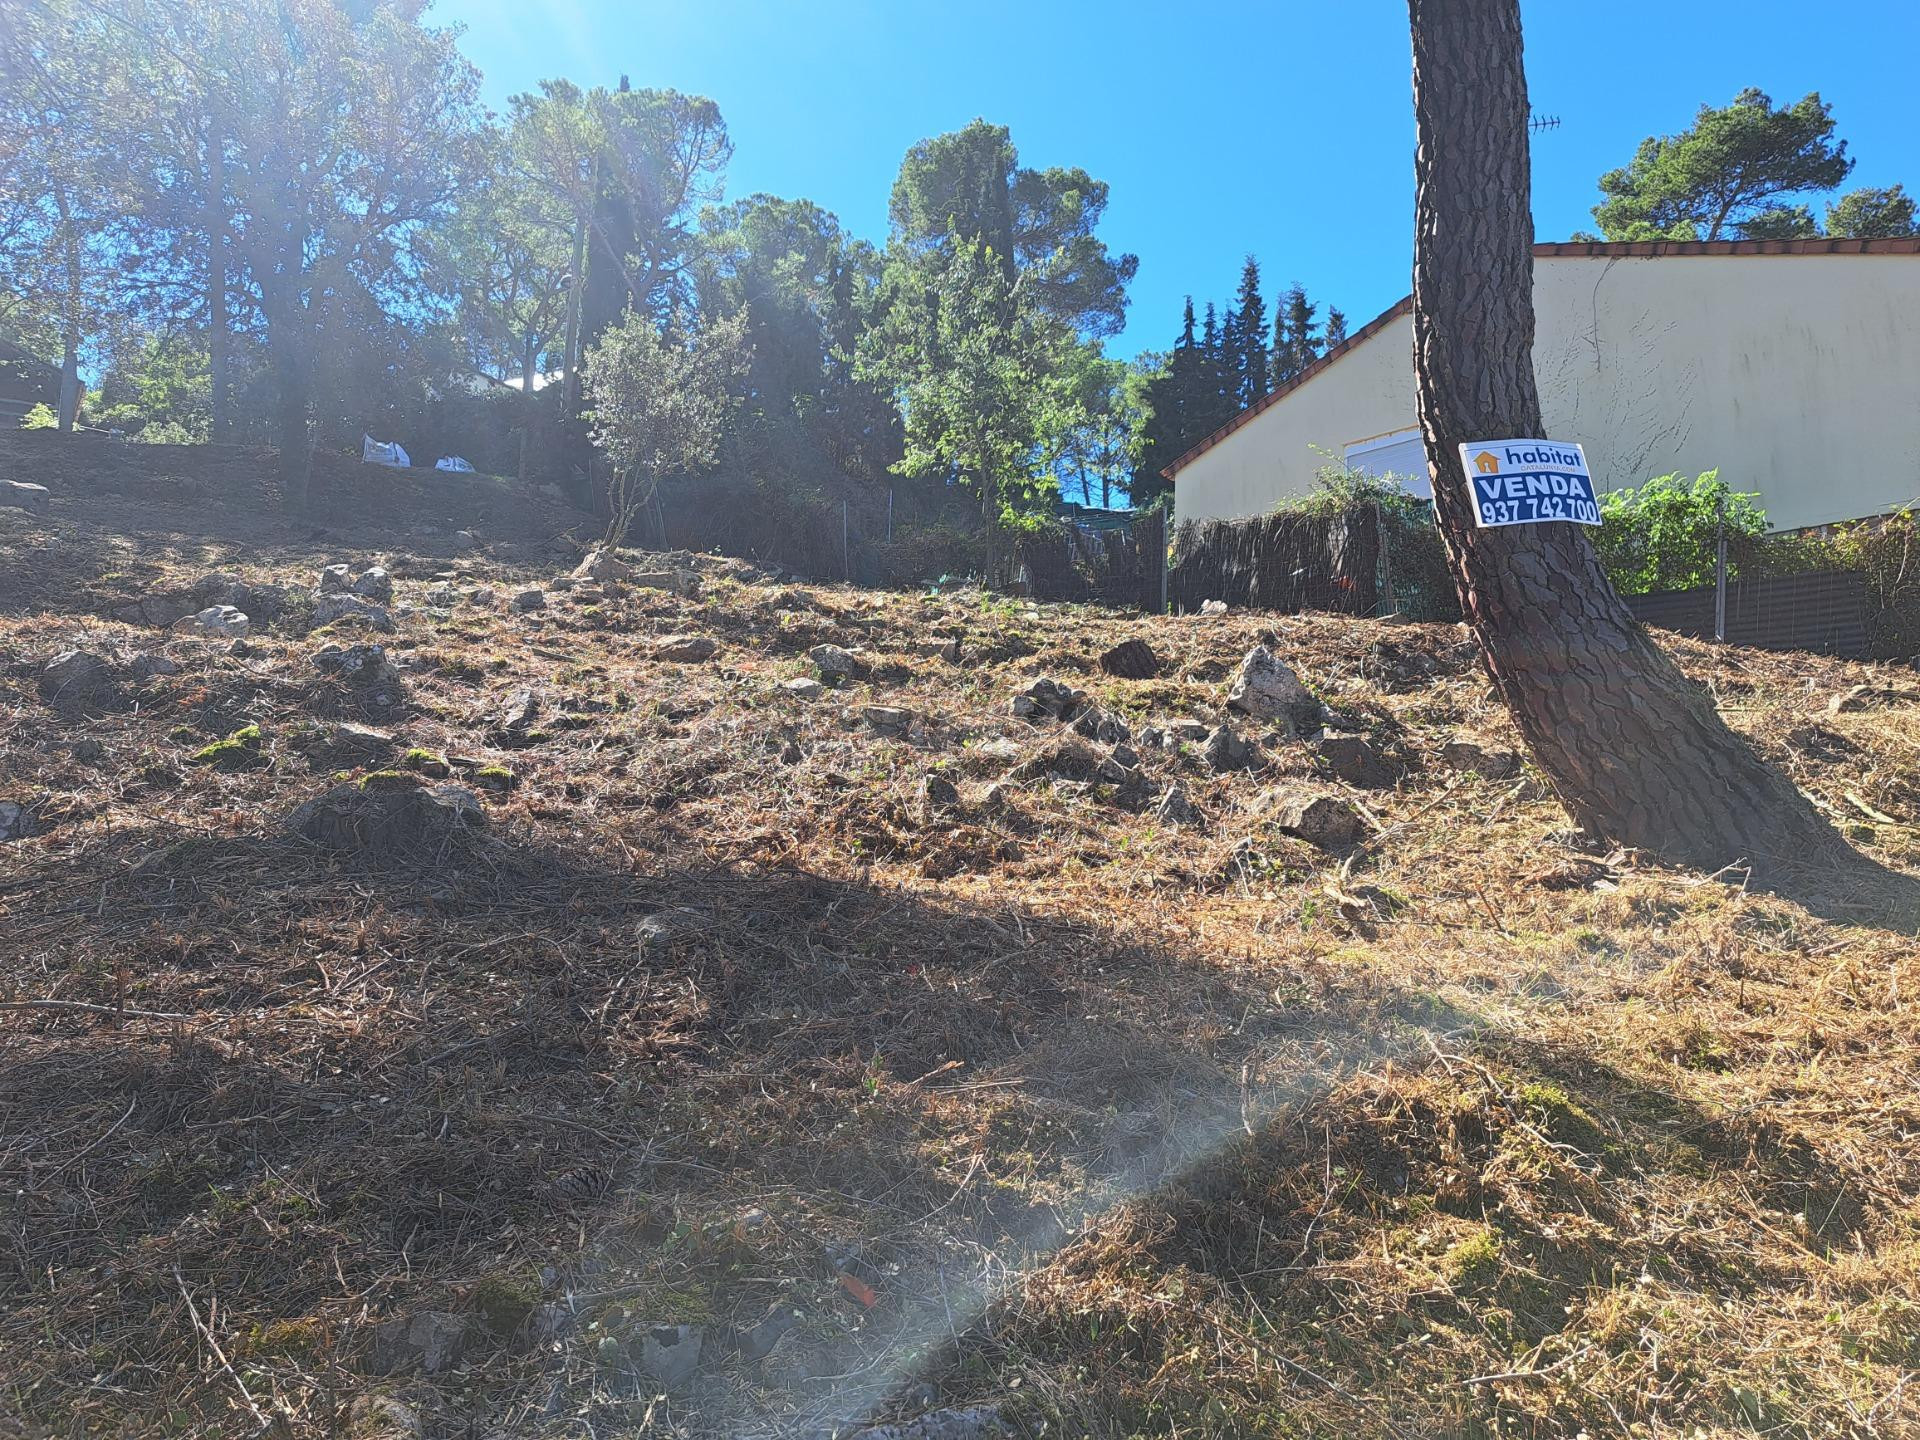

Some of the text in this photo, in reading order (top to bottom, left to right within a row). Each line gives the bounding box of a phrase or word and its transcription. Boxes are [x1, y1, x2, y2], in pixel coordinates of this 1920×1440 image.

[1505, 447, 1581, 466] habitat
[1478, 474, 1587, 499] VENDA
[1482, 497, 1597, 523] 937 742 700
